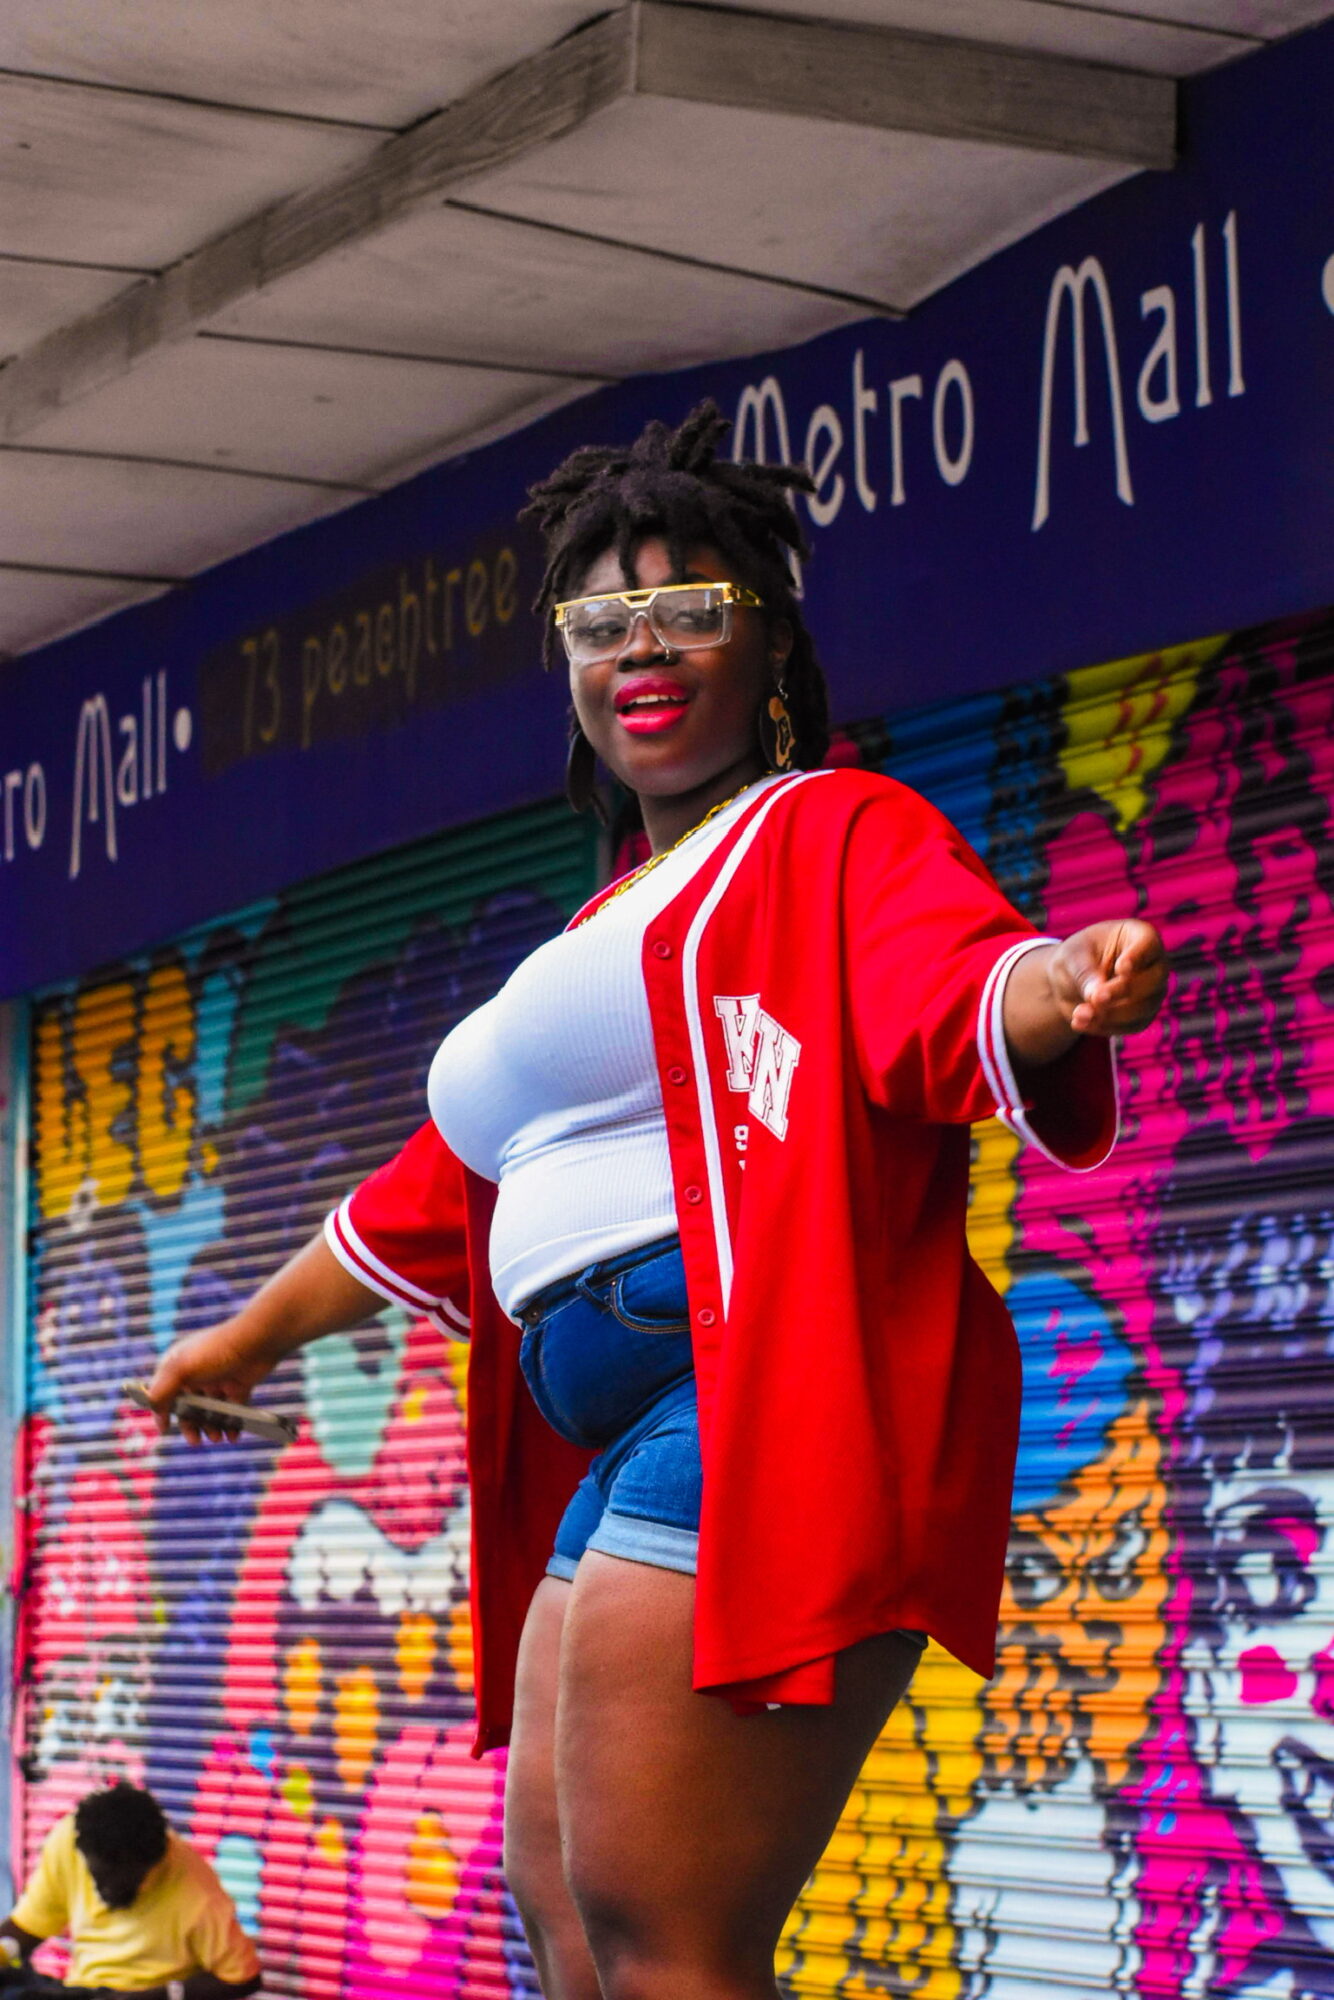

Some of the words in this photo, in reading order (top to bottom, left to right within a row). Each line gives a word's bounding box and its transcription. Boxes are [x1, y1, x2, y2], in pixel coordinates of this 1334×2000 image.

[732, 349, 975, 599] Metro
[1031, 209, 1246, 533] Mall
[69, 667, 168, 881] Mall
